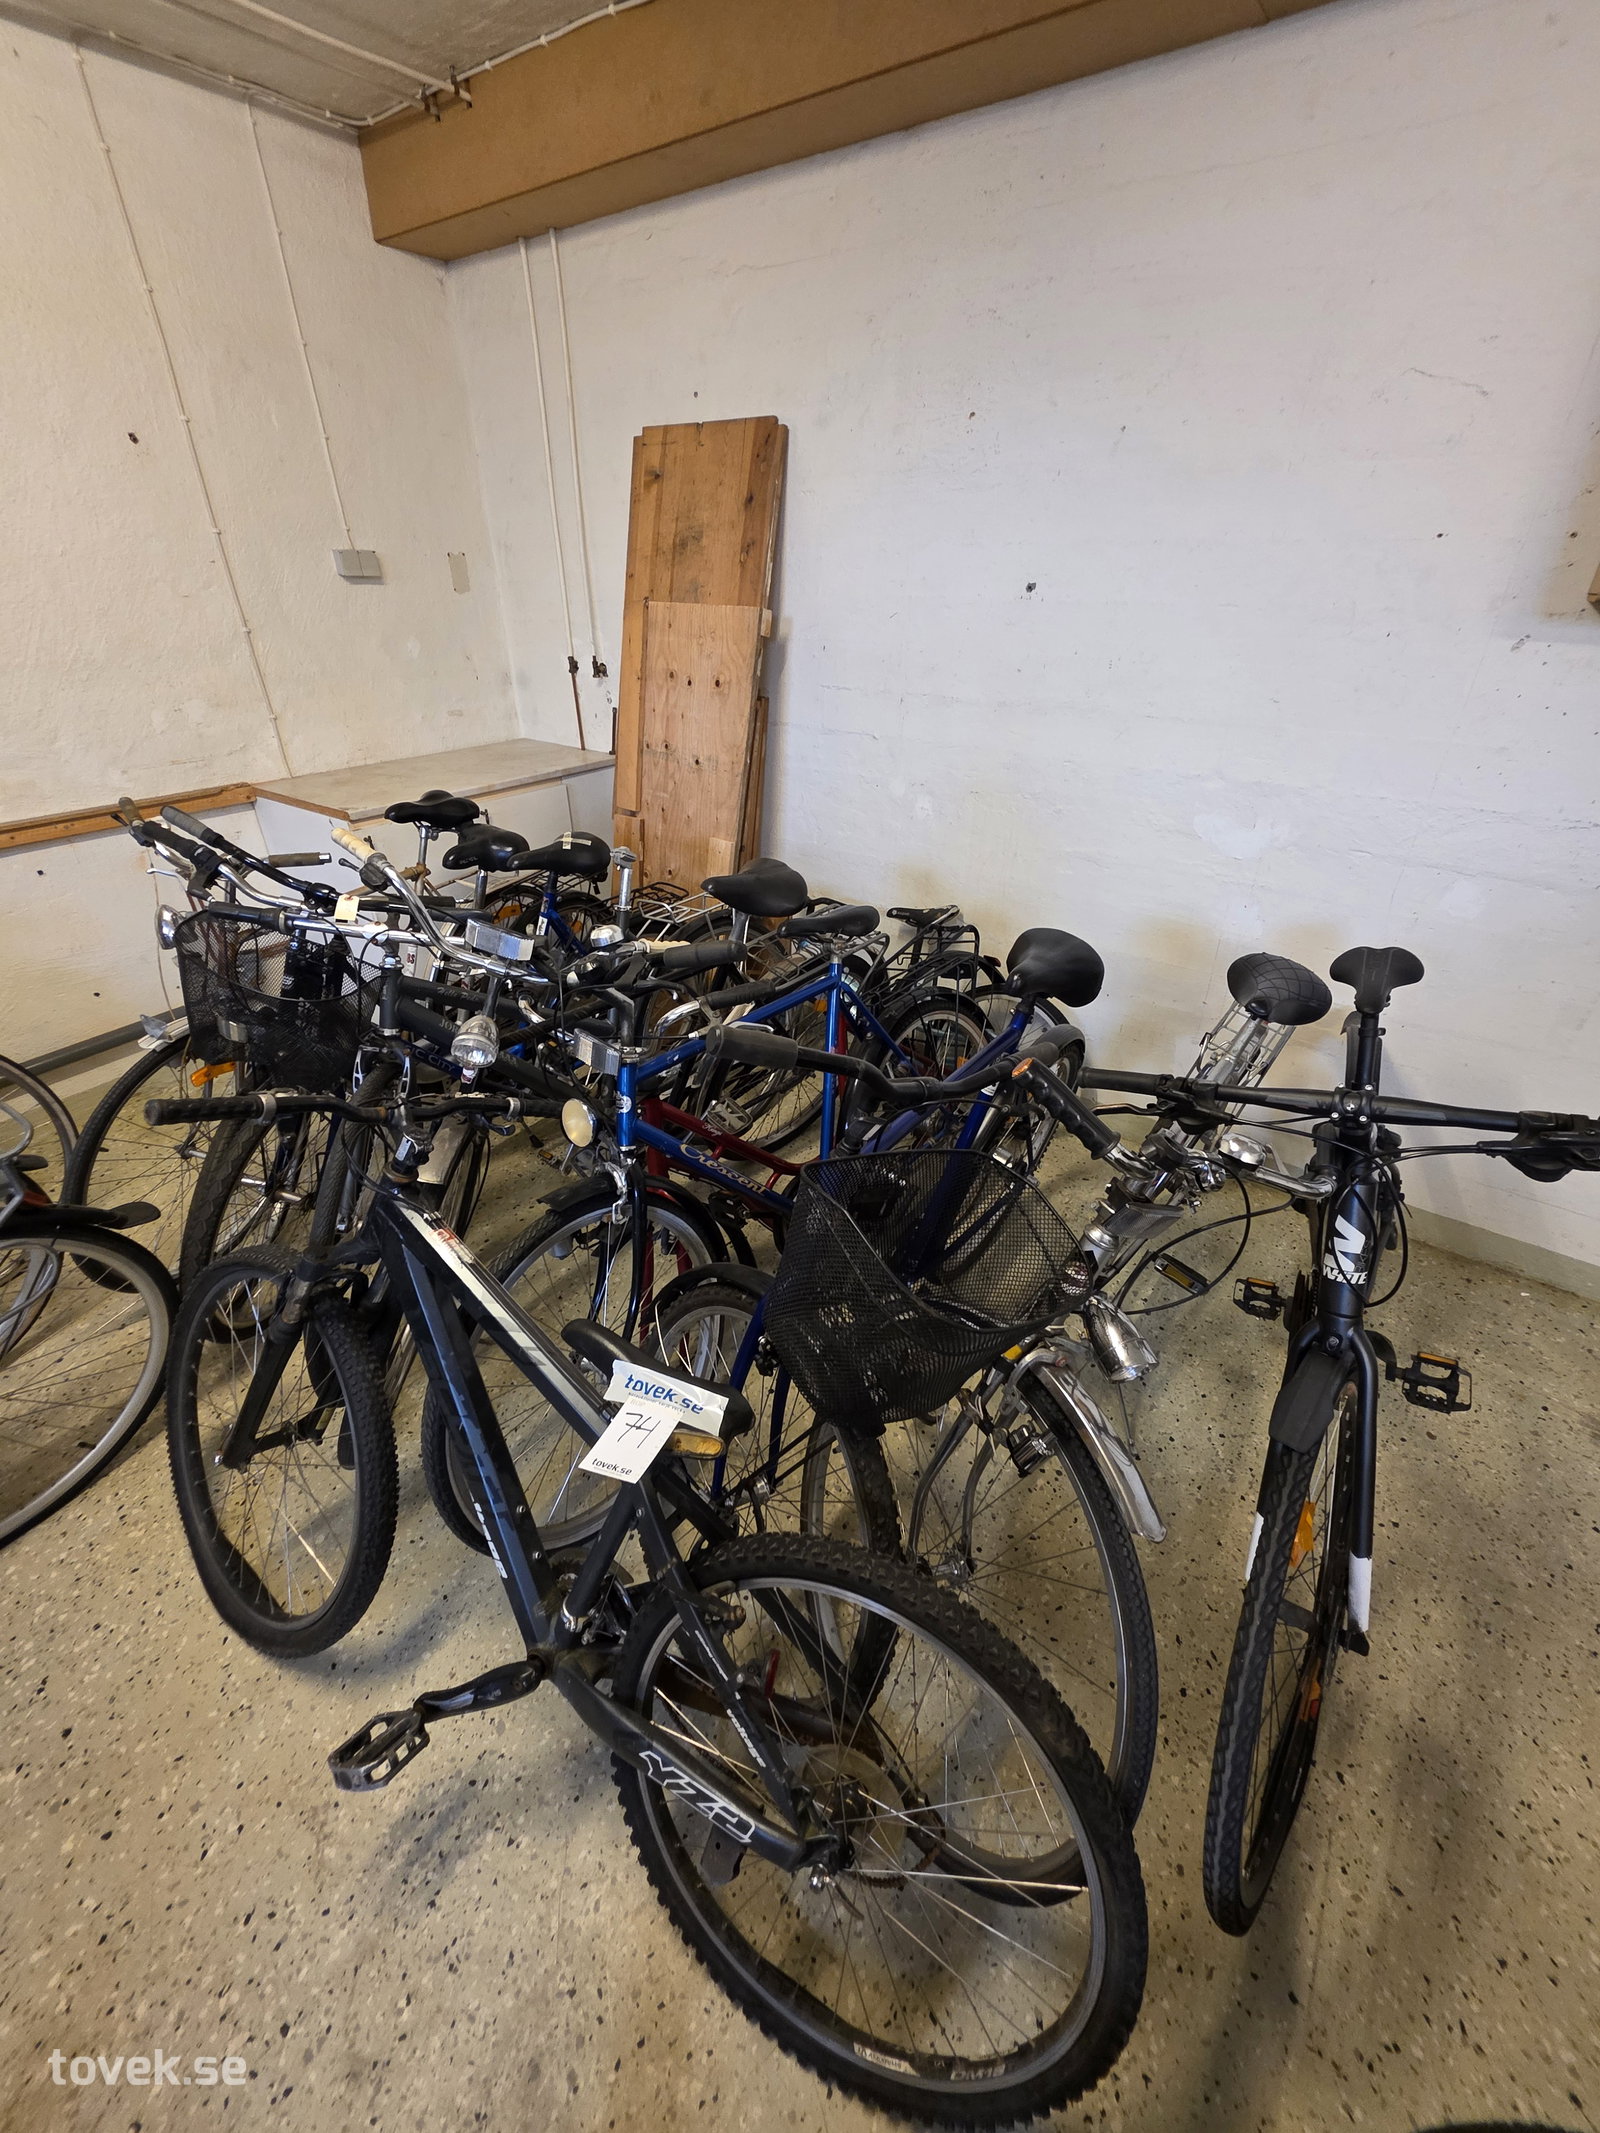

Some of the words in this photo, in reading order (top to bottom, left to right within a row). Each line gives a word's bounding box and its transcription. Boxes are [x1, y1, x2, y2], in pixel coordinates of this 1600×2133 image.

[680, 1143, 768, 1196] Crescent
[1322, 1264, 1368, 1285] WHITE
[624, 1373, 704, 1415] tovek.se
[617, 1411, 661, 1449] 74
[592, 1457, 633, 1476] tovek.se
[726, 1708, 767, 1768] voltage
